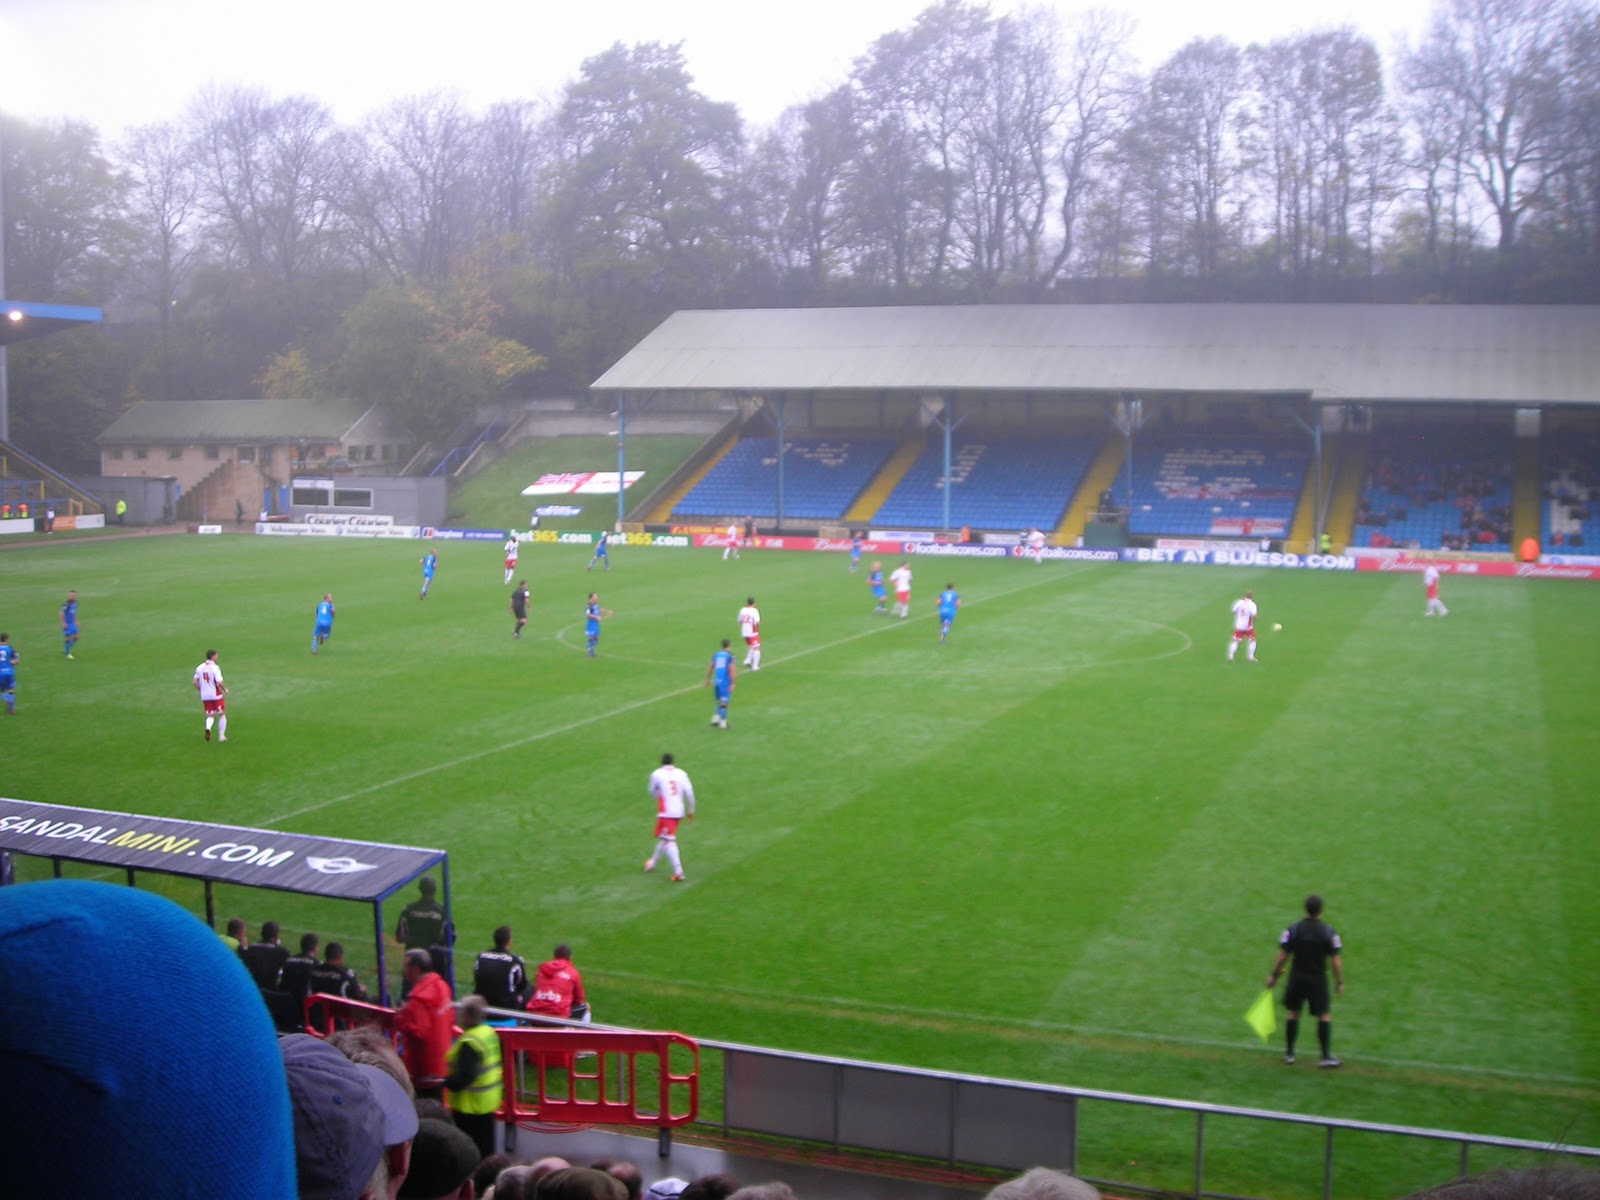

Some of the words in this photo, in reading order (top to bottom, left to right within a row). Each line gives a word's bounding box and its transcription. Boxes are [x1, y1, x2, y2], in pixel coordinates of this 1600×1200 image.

[915, 543, 1006, 557] footballscores.com
[1137, 548, 1177, 562] BET
[1183, 550, 1210, 563] AT
[668, 780, 678, 796] 3
[0, 815, 294, 868] SANDALMINI.COM
